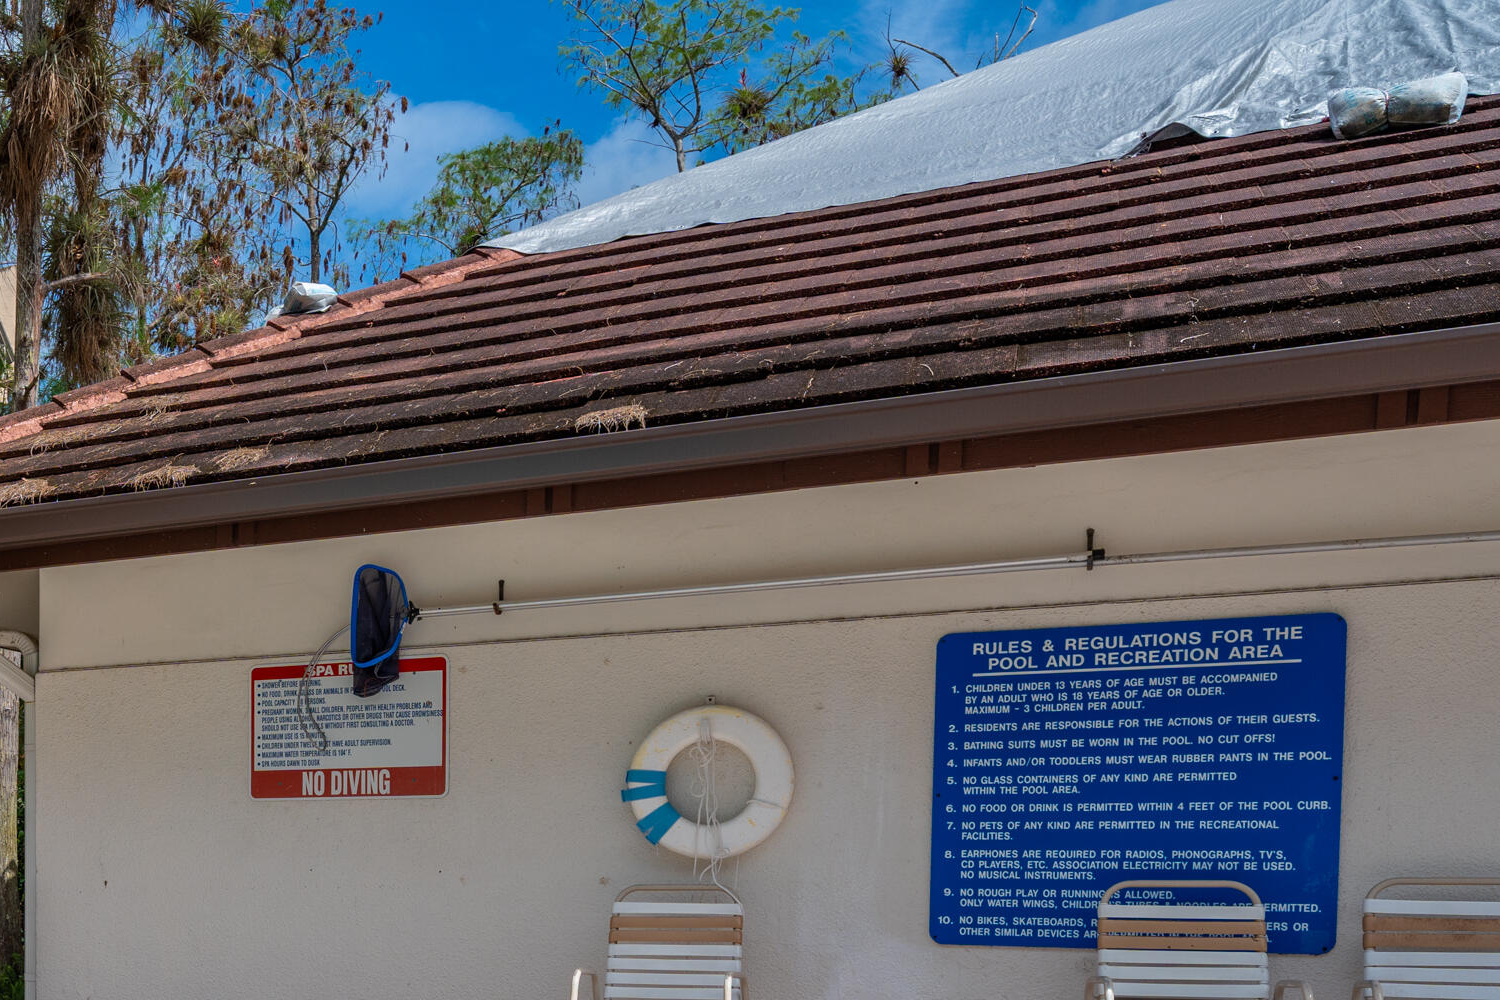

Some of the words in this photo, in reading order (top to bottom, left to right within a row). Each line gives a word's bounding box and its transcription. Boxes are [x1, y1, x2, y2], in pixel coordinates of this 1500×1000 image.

[972, 640, 1032, 655] RULES
[1042, 639, 1054, 652] &
[1064, 631, 1201, 651] REGULATIONS
[1211, 628, 1253, 643] FOR
[1262, 626, 1303, 641] THE
[988, 656, 1038, 670] POOL
[1045, 653, 1085, 668] AND
[1094, 647, 1219, 665] RECREATION
[1228, 644, 1283, 659] AREA
[307, 665, 334, 677] SPA
[281, 680, 298, 688] BEFORE
[965, 683, 1013, 693] CHILDREN
[1017, 681, 1051, 691] UNDER
[1055, 680, 1065, 690] 13
[1069, 679, 1102, 689] YEARS
[1106, 678, 1120, 688] OF
[1123, 677, 1144, 687] AGE
[1148, 676, 1178, 686] MUST
[1181, 675, 1195, 685] BE
[1200, 672, 1278, 684] ACCOMPANIED
[323, 687, 344, 695] ANIMALS
[393, 684, 405, 692] DECK.
[965, 695, 977, 705] BY
[980, 695, 994, 704] AN
[997, 693, 1027, 703] ADULT
[1030, 692, 1054, 702] WHO
[1058, 691, 1068, 701] IS
[1072, 691, 1083, 700] 18
[1087, 690, 1120, 700] YEARS
[1124, 689, 1138, 699] OF
[1141, 688, 1162, 698] AGE
[1166, 688, 1182, 697] OR
[1186, 686, 1225, 696] OLDER.
[262, 708, 285, 716] PREGNANT
[346, 704, 364, 712] PEOPLE
[377, 703, 395, 711] HEALTH
[396, 702, 422, 710] PROBLEMS
[964, 705, 1010, 715] MAXIMUM
[1034, 702, 1083, 713] CHILDREN
[1087, 701, 1107, 711] PER
[1110, 700, 1144, 710] ADULT.
[262, 716, 278, 724] PEOPLE
[350, 712, 365, 720] OTHER
[383, 711, 395, 719] THAT
[411, 709, 443, 718] DROWSINESS
[964, 722, 1018, 732] RESIDENTS
[1021, 721, 1040, 730] ARE
[1044, 719, 1114, 730] RESPONSIBLE
[1118, 718, 1139, 728] FOR
[1143, 718, 1163, 727] THE
[1167, 716, 1213, 727] ACTIONS
[1217, 715, 1232, 725] OF
[1236, 714, 1268, 724] THEIR
[1272, 712, 1320, 724] GUESTS.
[262, 724, 279, 732] SHOULD
[325, 721, 345, 729] WITHOUT
[394, 719, 415, 727] DOCTOR.
[262, 733, 285, 741] MAXIMUM
[359, 738, 392, 747] SUPERVISION.
[963, 740, 1004, 750] BATHING
[1007, 739, 1036, 749] SUITS
[1040, 739, 1067, 748] MUST
[1071, 738, 1084, 748] BE
[1088, 737, 1119, 747] WORN
[1123, 737, 1134, 746] IN
[1138, 736, 1158, 746] THE
[1162, 735, 1193, 745] POOL.
[1197, 735, 1214, 744] NO
[1217, 734, 1240, 744] CUT
[1243, 733, 1275, 743] OFFS!
[284, 750, 299, 758] WATER
[963, 758, 1002, 767] INFANTS
[1006, 757, 1045, 766] AND/OR
[1049, 755, 1101, 766] TODDLERS
[1105, 755, 1134, 765] MUST
[1137, 754, 1167, 764] WEAR
[1171, 753, 1214, 763] RUBBER
[1219, 752, 1253, 762] PANTS
[1257, 752, 1268, 761] IN
[1273, 751, 1294, 761] THE
[1299, 750, 1332, 761] POOL.
[302, 770, 325, 796] NO
[331, 769, 391, 796] DIVING
[962, 776, 977, 785] NO
[980, 775, 1013, 785] GLASS
[1016, 774, 1079, 784] CONTAINERS
[1082, 774, 1097, 783] OF
[1099, 774, 1120, 782] ANY
[1124, 773, 1149, 782] KIND
[1152, 772, 1173, 782] ARE
[1177, 771, 1237, 781] PERMITTED
[962, 803, 976, 813] NO
[980, 803, 1007, 813] FOOD
[1010, 803, 1025, 812] OR
[1028, 803, 1059, 812] DRINK
[1063, 802, 1073, 812] IS
[1077, 802, 1133, 812] PERMITTED
[1137, 802, 1173, 811] WITHIN
[1177, 802, 1184, 810] 4
[1188, 801, 1215, 811] FEET
[1218, 801, 1233, 811] OF
[1237, 801, 1258, 810] THE
[1263, 800, 1293, 811] POOL
[1297, 800, 1331, 810] CURB.
[961, 821, 976, 830] NO
[979, 821, 1003, 830] PETS
[1007, 821, 1020, 830] OF
[1023, 821, 1043, 829] ANY
[1046, 821, 1071, 830] KIND
[1074, 820, 1094, 830] ARE
[1098, 820, 1156, 829] PERMITTED
[1159, 820, 1170, 829] IN
[1174, 820, 1194, 829] THE
[1199, 820, 1279, 829] RECREATIONAL
[961, 831, 1013, 841] FACILITIES.
[960, 849, 1018, 858] EARPHONES
[1022, 849, 1041, 859] ARE
[1045, 849, 1096, 859] REQUIRED
[1100, 849, 1121, 859] FOR
[1125, 849, 1167, 860] RADIOS,
[1171, 850, 1254, 861] PHONOGRAPHS,
[1259, 850, 1286, 861] TV'S,
[960, 859, 975, 869] CD
[978, 860, 1023, 870] PLAYERS,
[1027, 860, 1048, 869] ETC.
[1052, 860, 1118, 870] ASSOCIATION
[1122, 860, 1188, 870] ELECTRICITY
[1192, 861, 1213, 870] MAY
[1217, 861, 1239, 870] NOT
[1243, 861, 1258, 871] BE
[1262, 861, 1296, 871] USED.
